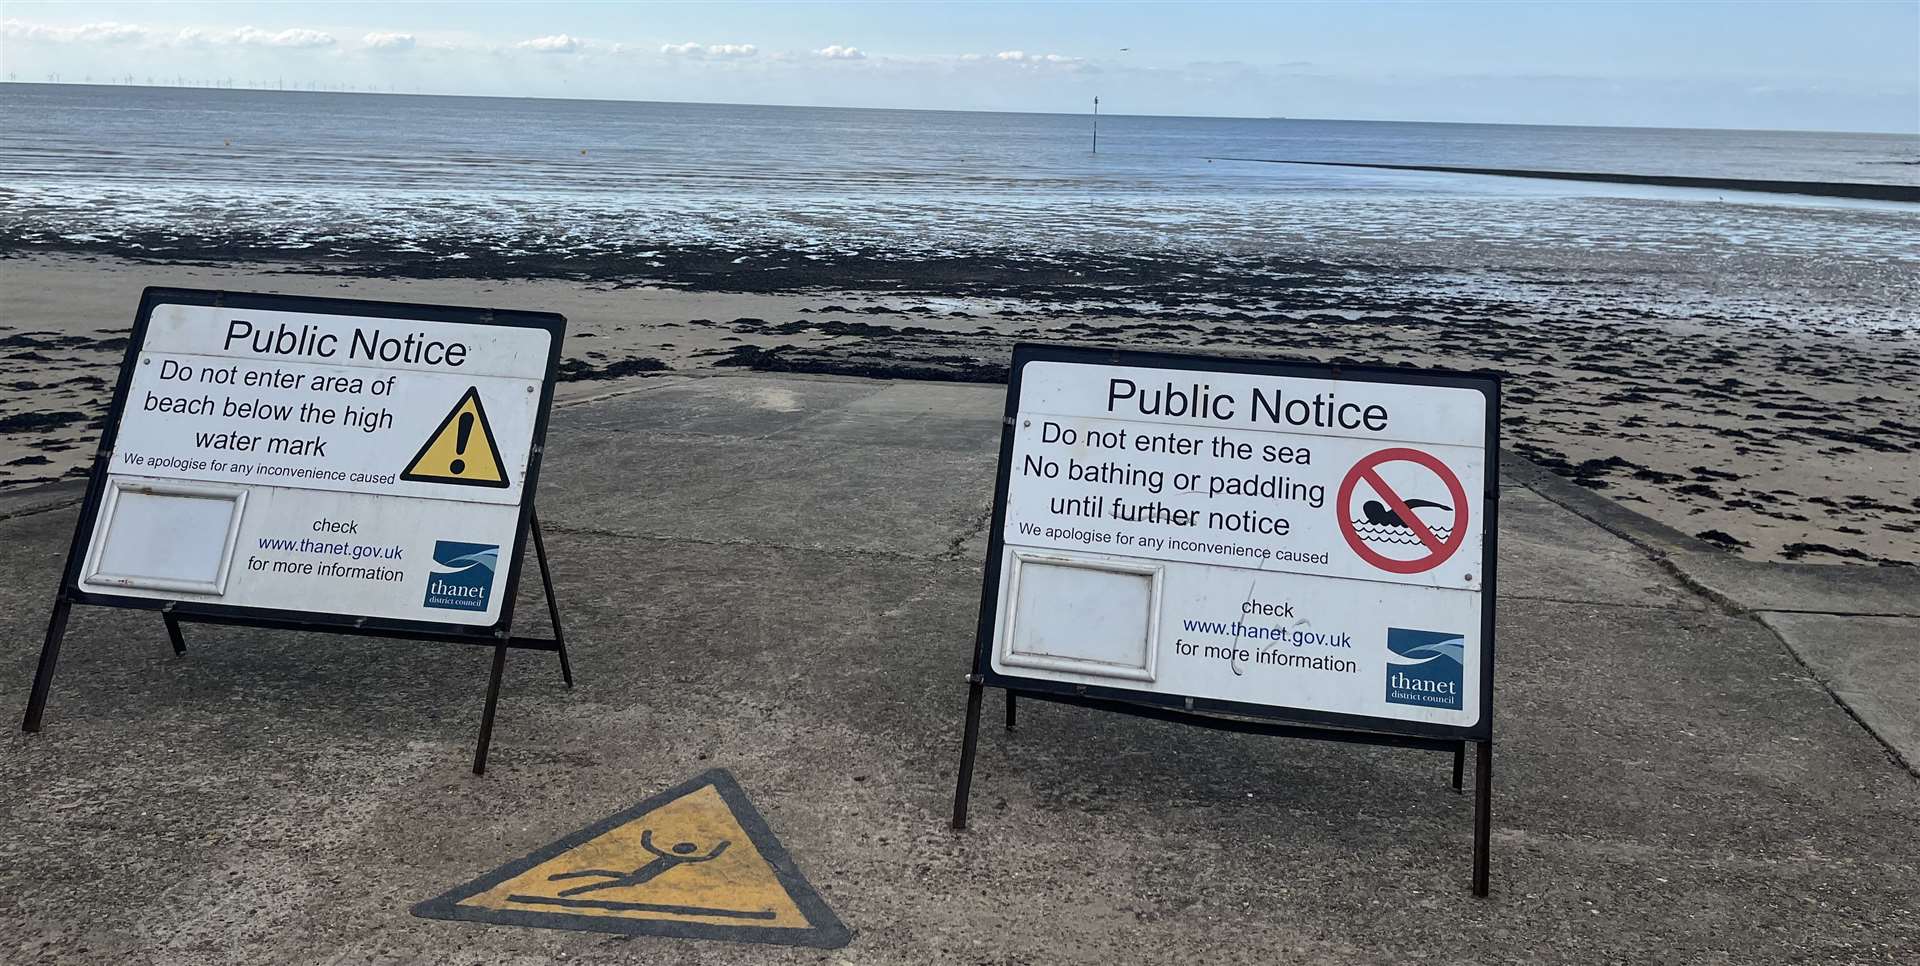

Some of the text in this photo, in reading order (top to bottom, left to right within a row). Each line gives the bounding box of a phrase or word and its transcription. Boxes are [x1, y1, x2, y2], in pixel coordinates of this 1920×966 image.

[224, 320, 466, 366] Public Notice
[160, 360, 396, 395] Do not enter area of
[144, 391, 392, 432] beach below the high
[1108, 379, 1388, 431] Public Notice
[197, 431, 327, 456] water mark
[1042, 422, 1310, 464] Do not enter the sea
[124, 452, 396, 485] We apologise for any inconvenience caused
[1024, 455, 1324, 508] No bathing or paddling
[312, 517, 359, 535] check
[1051, 496, 1289, 535] until further notice
[258, 537, 404, 560] www.thanet.gov.uk
[1019, 521, 1329, 565] We apologise for any inconvenience caused
[247, 555, 403, 581] for more information
[429, 596, 482, 607] district council
[430, 580, 485, 599] thanet
[1242, 600, 1293, 618] check
[1183, 618, 1352, 649] www.thanet.gov.uk
[1175, 638, 1356, 673] for more information
[1391, 672, 1456, 695] thanet
[1391, 690, 1455, 704] district council
